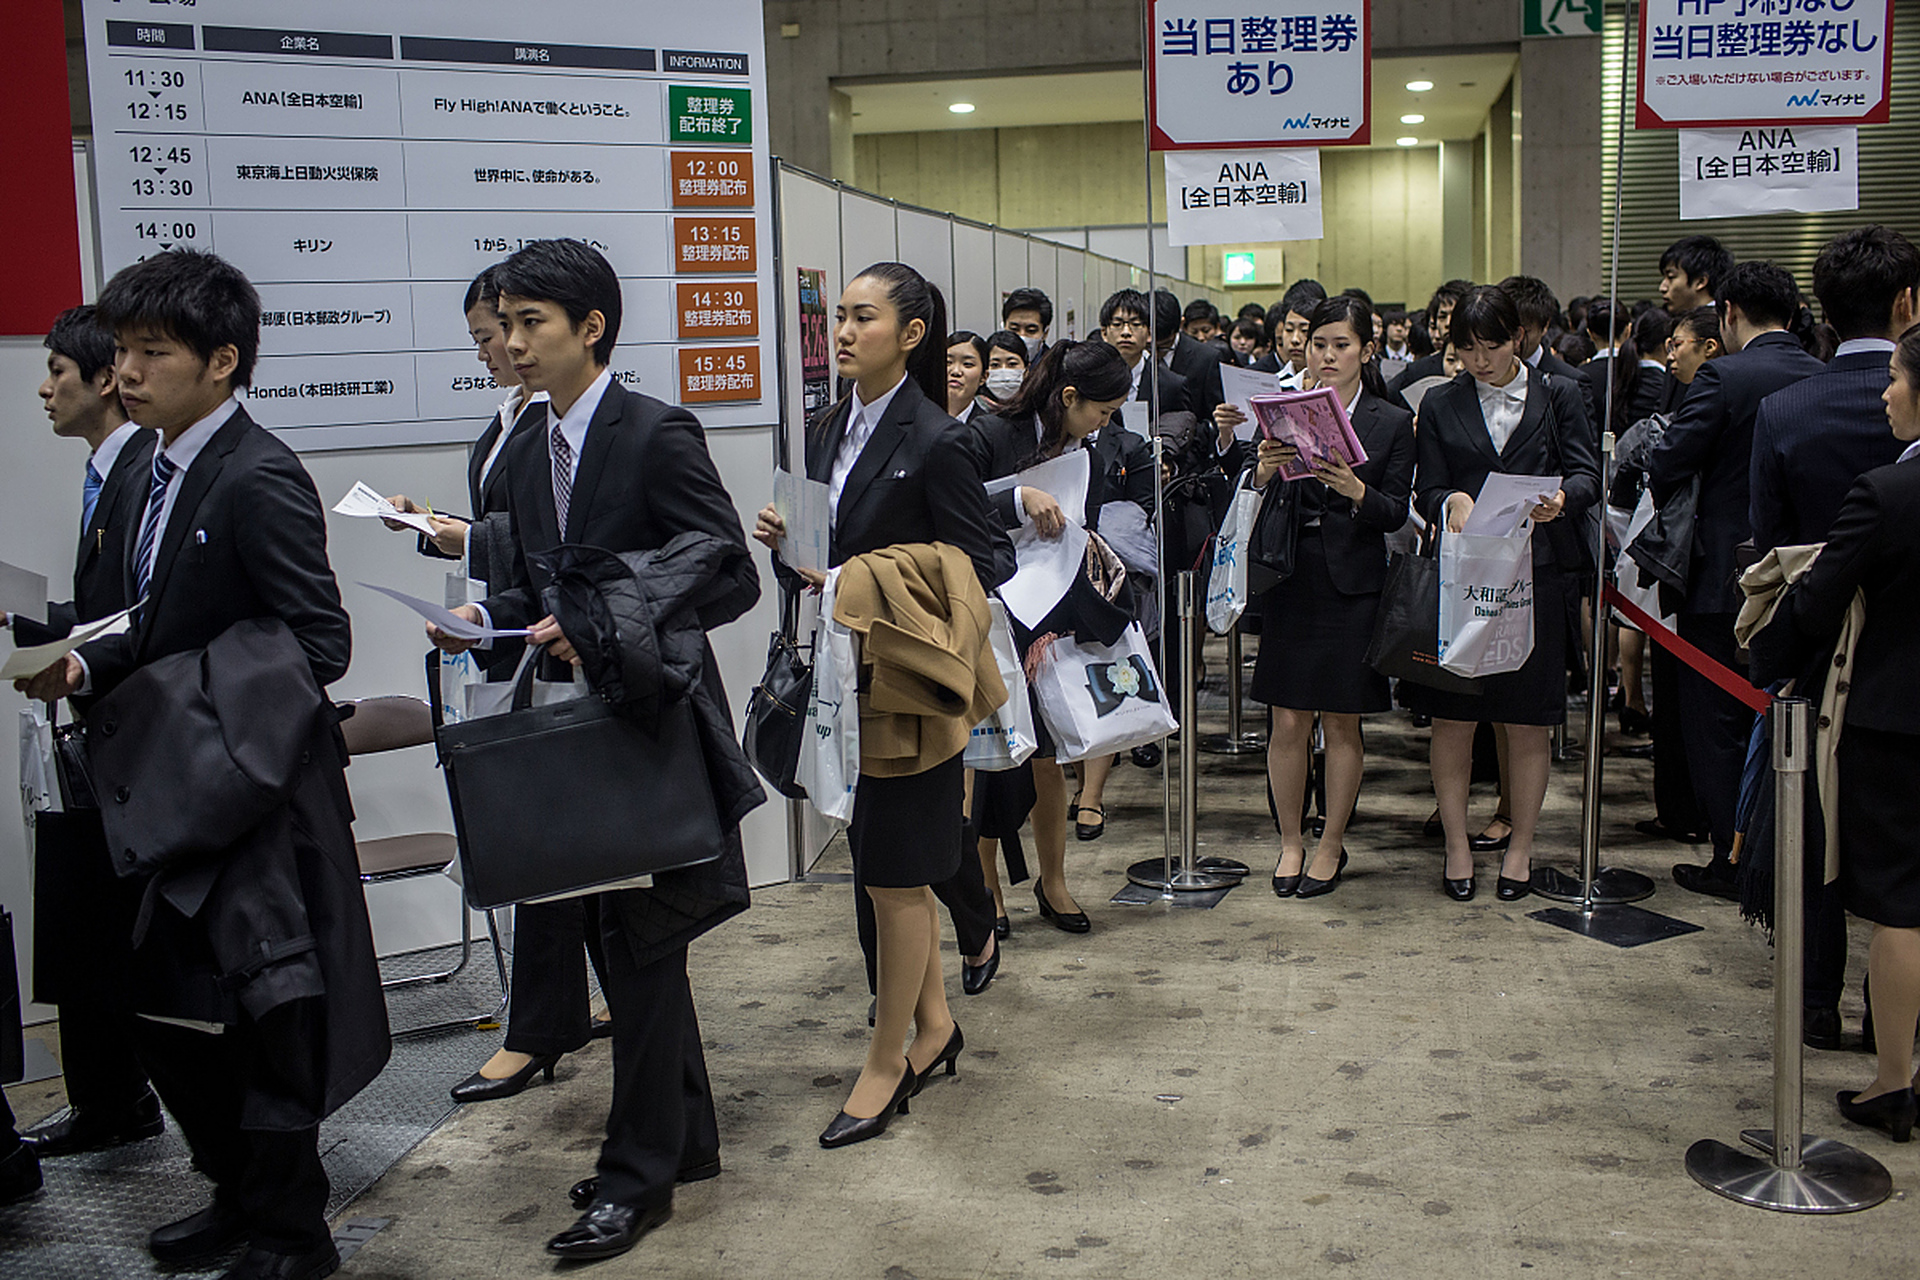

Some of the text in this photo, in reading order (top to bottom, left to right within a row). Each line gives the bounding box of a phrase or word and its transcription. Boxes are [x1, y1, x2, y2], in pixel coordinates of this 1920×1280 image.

[136, 28, 166, 43] 時間
[280, 36, 319, 51] 企業名
[1162, 14, 1358, 57] 当日整理券
[1652, 19, 1878, 60] 当日整理券なし
[515, 48, 550, 62] 講演名
[670, 56, 743, 71] INFORMATION
[124, 70, 185, 87] 11:30
[1226, 61, 1294, 96] あり
[1655, 69, 1871, 86] ※ご入場いただけない場合がございます。
[434, 98, 456, 113] Fly
[686, 97, 735, 115] 整理券
[1820, 93, 1865, 106] マイナビ
[127, 103, 187, 120] 12:15
[679, 116, 742, 134] 配布終了
[1311, 117, 1350, 129] マイナビ
[1739, 128, 1797, 151] ANA
[129, 147, 191, 163] 12:45
[1696, 147, 1840, 180] 【全日本空輸】
[236, 165, 379, 181] 東京海上日動火災保険
[474, 168, 601, 184] 世界中に、使命がある。
[686, 161, 739, 175] 12:00
[1218, 162, 1269, 183] ANA
[132, 179, 193, 196] 13:30
[678, 179, 747, 196] 整理券配布
[1180, 181, 1307, 210] 【全日本空輸】
[135, 222, 196, 240] 14:00
[690, 226, 741, 241] 13:15
[293, 239, 333, 253] キリン
[682, 244, 750, 262] 整理券配布
[691, 291, 744, 307] 14:30
[258, 310, 391, 327] 郵便(日本郵政グループ)
[684, 310, 752, 327] 整理券配布
[694, 356, 746, 371] 15:45
[686, 374, 754, 391] 整理券配布
